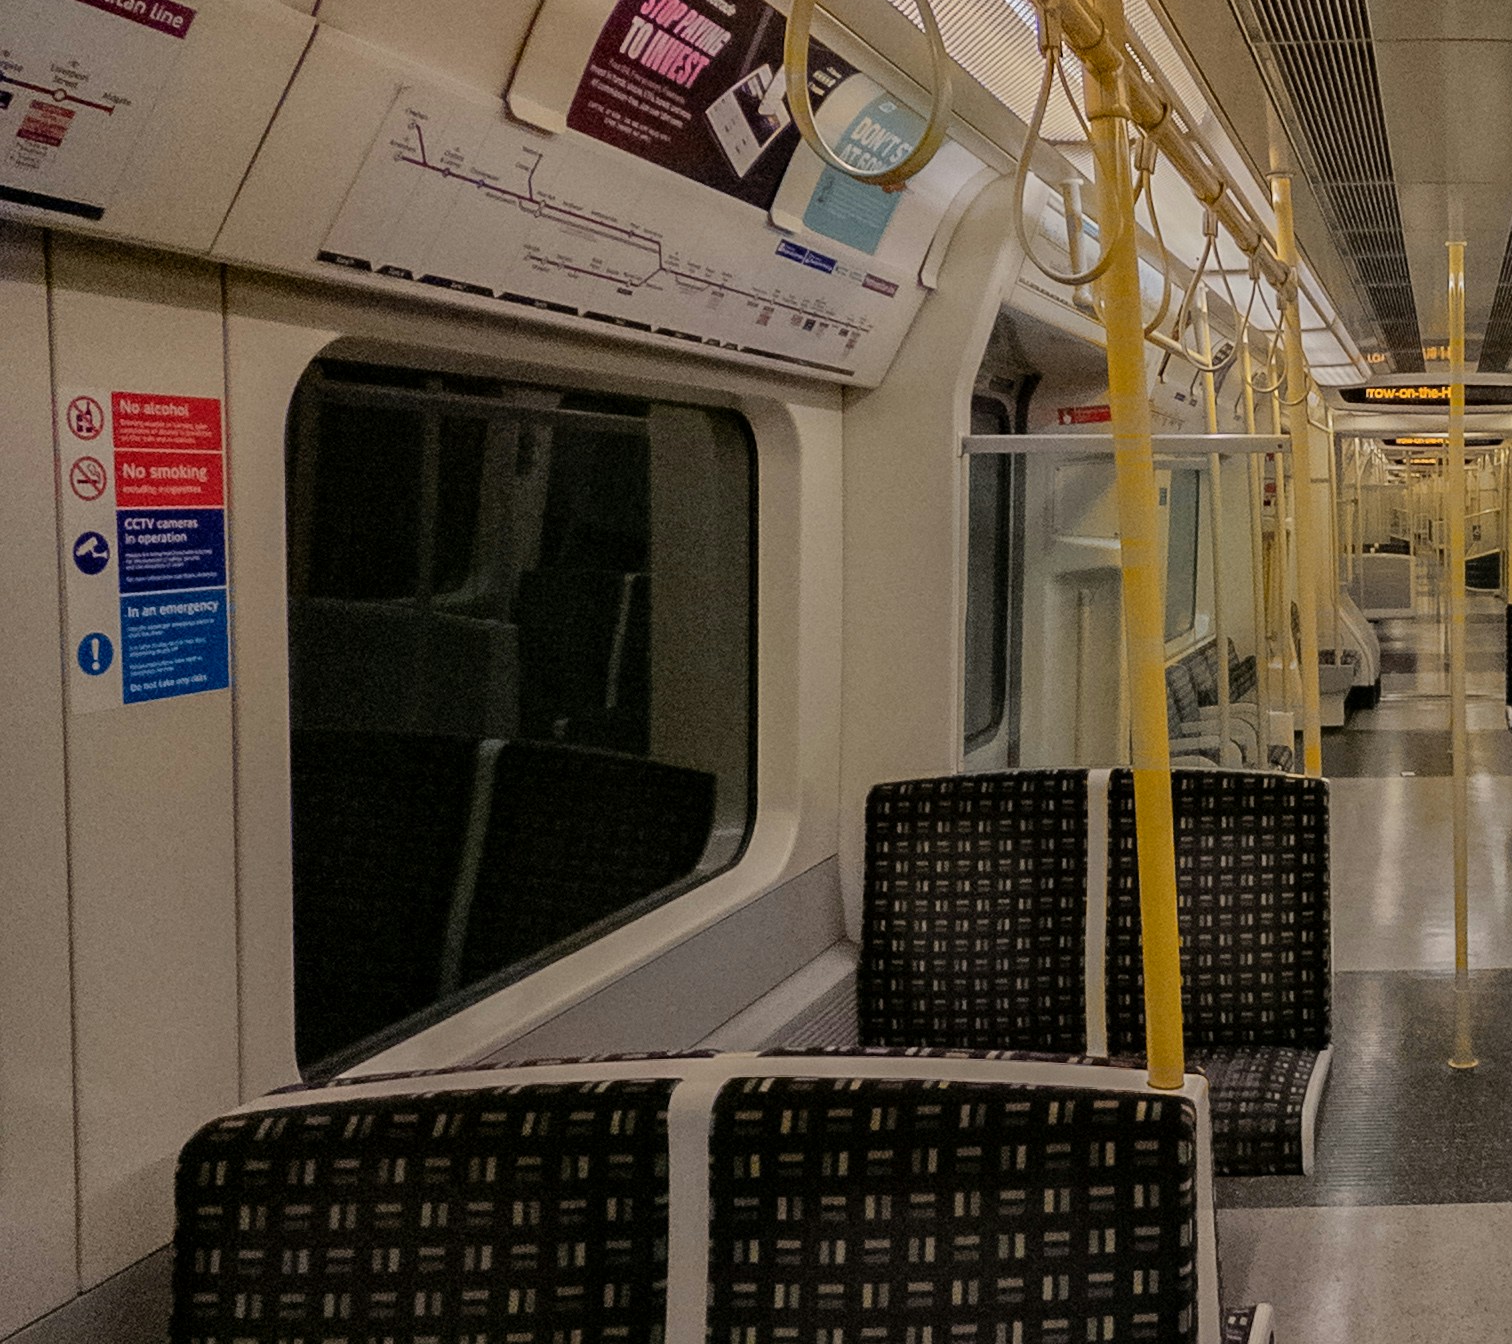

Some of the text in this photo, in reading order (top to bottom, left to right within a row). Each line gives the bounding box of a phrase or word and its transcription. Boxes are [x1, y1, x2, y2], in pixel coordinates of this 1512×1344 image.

[150, 2, 184, 29] line
[673, 9, 732, 57] PAYING
[619, 15, 654, 60] TO
[640, 29, 711, 90] INVEST
[120, 399, 190, 416] No alcohol
[122, 462, 208, 483] No smoking
[124, 518, 199, 530] CCTV cameras
[137, 531, 188, 545] operation
[127, 600, 220, 618] In an emergency
